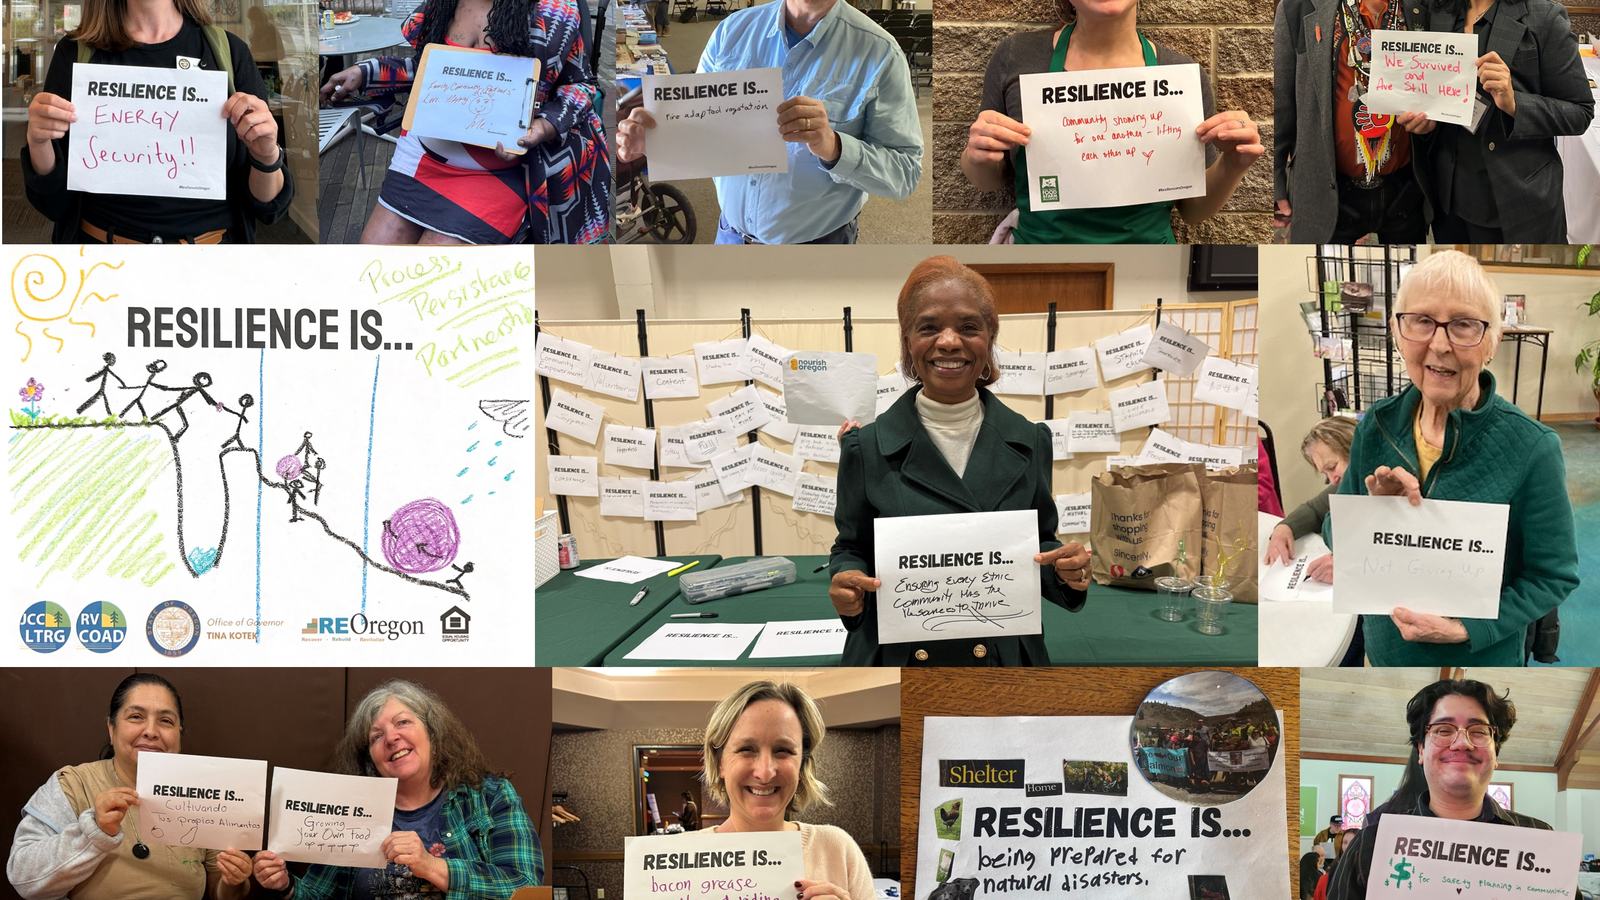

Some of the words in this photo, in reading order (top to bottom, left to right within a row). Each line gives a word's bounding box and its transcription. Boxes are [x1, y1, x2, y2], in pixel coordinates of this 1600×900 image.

[1381, 41, 1441, 54] RESILIENCE
[1445, 44, 1463, 56] IS...
[1410, 55, 1462, 73] Survived
[442, 66, 494, 80] RESILIENCE
[496, 72, 512, 82] IS...
[1404, 72, 1425, 81] and
[88, 81, 177, 100] RESILIENCE
[182, 86, 208, 102] IS...
[654, 83, 737, 101] RESILIENCE
[743, 82, 768, 95] IS...
[1042, 81, 1146, 104] RESILIENCE
[1153, 79, 1183, 97] IS...
[1404, 80, 1428, 95] Still
[95, 104, 179, 132] ENERGY
[1113, 113, 1148, 128] showing
[1150, 111, 1164, 122] up
[1073, 135, 1085, 145] for
[1112, 131, 1142, 141] another
[1157, 124, 1182, 140] lifting
[83, 136, 195, 179] Security!!
[1081, 152, 1099, 162] each
[1103, 149, 1122, 159] other
[1126, 147, 1136, 157] up
[359, 255, 451, 294] Process
[127, 306, 339, 350] RESILIENCE
[351, 309, 413, 351] IS...
[1112, 512, 1143, 522] Thanks
[1113, 523, 1148, 535] shopping
[1373, 532, 1463, 551] RESILIENCE
[1468, 539, 1494, 554] IS...
[898, 552, 984, 570] RESILIENCE
[988, 551, 1013, 566] IS...
[1363, 557, 1392, 576] Not
[20, 613, 45, 626] JCC
[81, 613, 100, 625] RV
[207, 618, 233, 627] Office
[234, 618, 245, 627] of
[247, 618, 284, 627] Governor
[25, 629, 66, 643] LTRG
[78, 629, 126, 643] COAD
[207, 632, 227, 640] TINA
[229, 631, 258, 640] KOTEK
[949, 765, 1017, 784] Shelter
[153, 784, 221, 800] RESILIENCE
[224, 790, 244, 802] IS...
[1026, 783, 1057, 793] Home
[165, 800, 228, 813] Cultivando
[285, 800, 350, 816] RESILIENCE
[352, 806, 372, 818] IS...
[303, 815, 346, 831] Growing
[973, 807, 1176, 838] RESILIENCE
[1191, 807, 1251, 838] IS...
[321, 828, 344, 840] Own
[346, 827, 371, 840] Food
[643, 851, 746, 871] RESILIENCE
[752, 850, 782, 866] IS...
[978, 845, 1036, 871] being
[1050, 846, 1138, 867] prepared
[1151, 847, 1186, 865] for
[1394, 837, 1508, 868] RESILIENCE
[1516, 851, 1551, 874] IS...
[651, 876, 692, 893] bacon
[701, 877, 758, 894] grease
[984, 873, 1052, 894] natural
[1418, 873, 1430, 883] for
